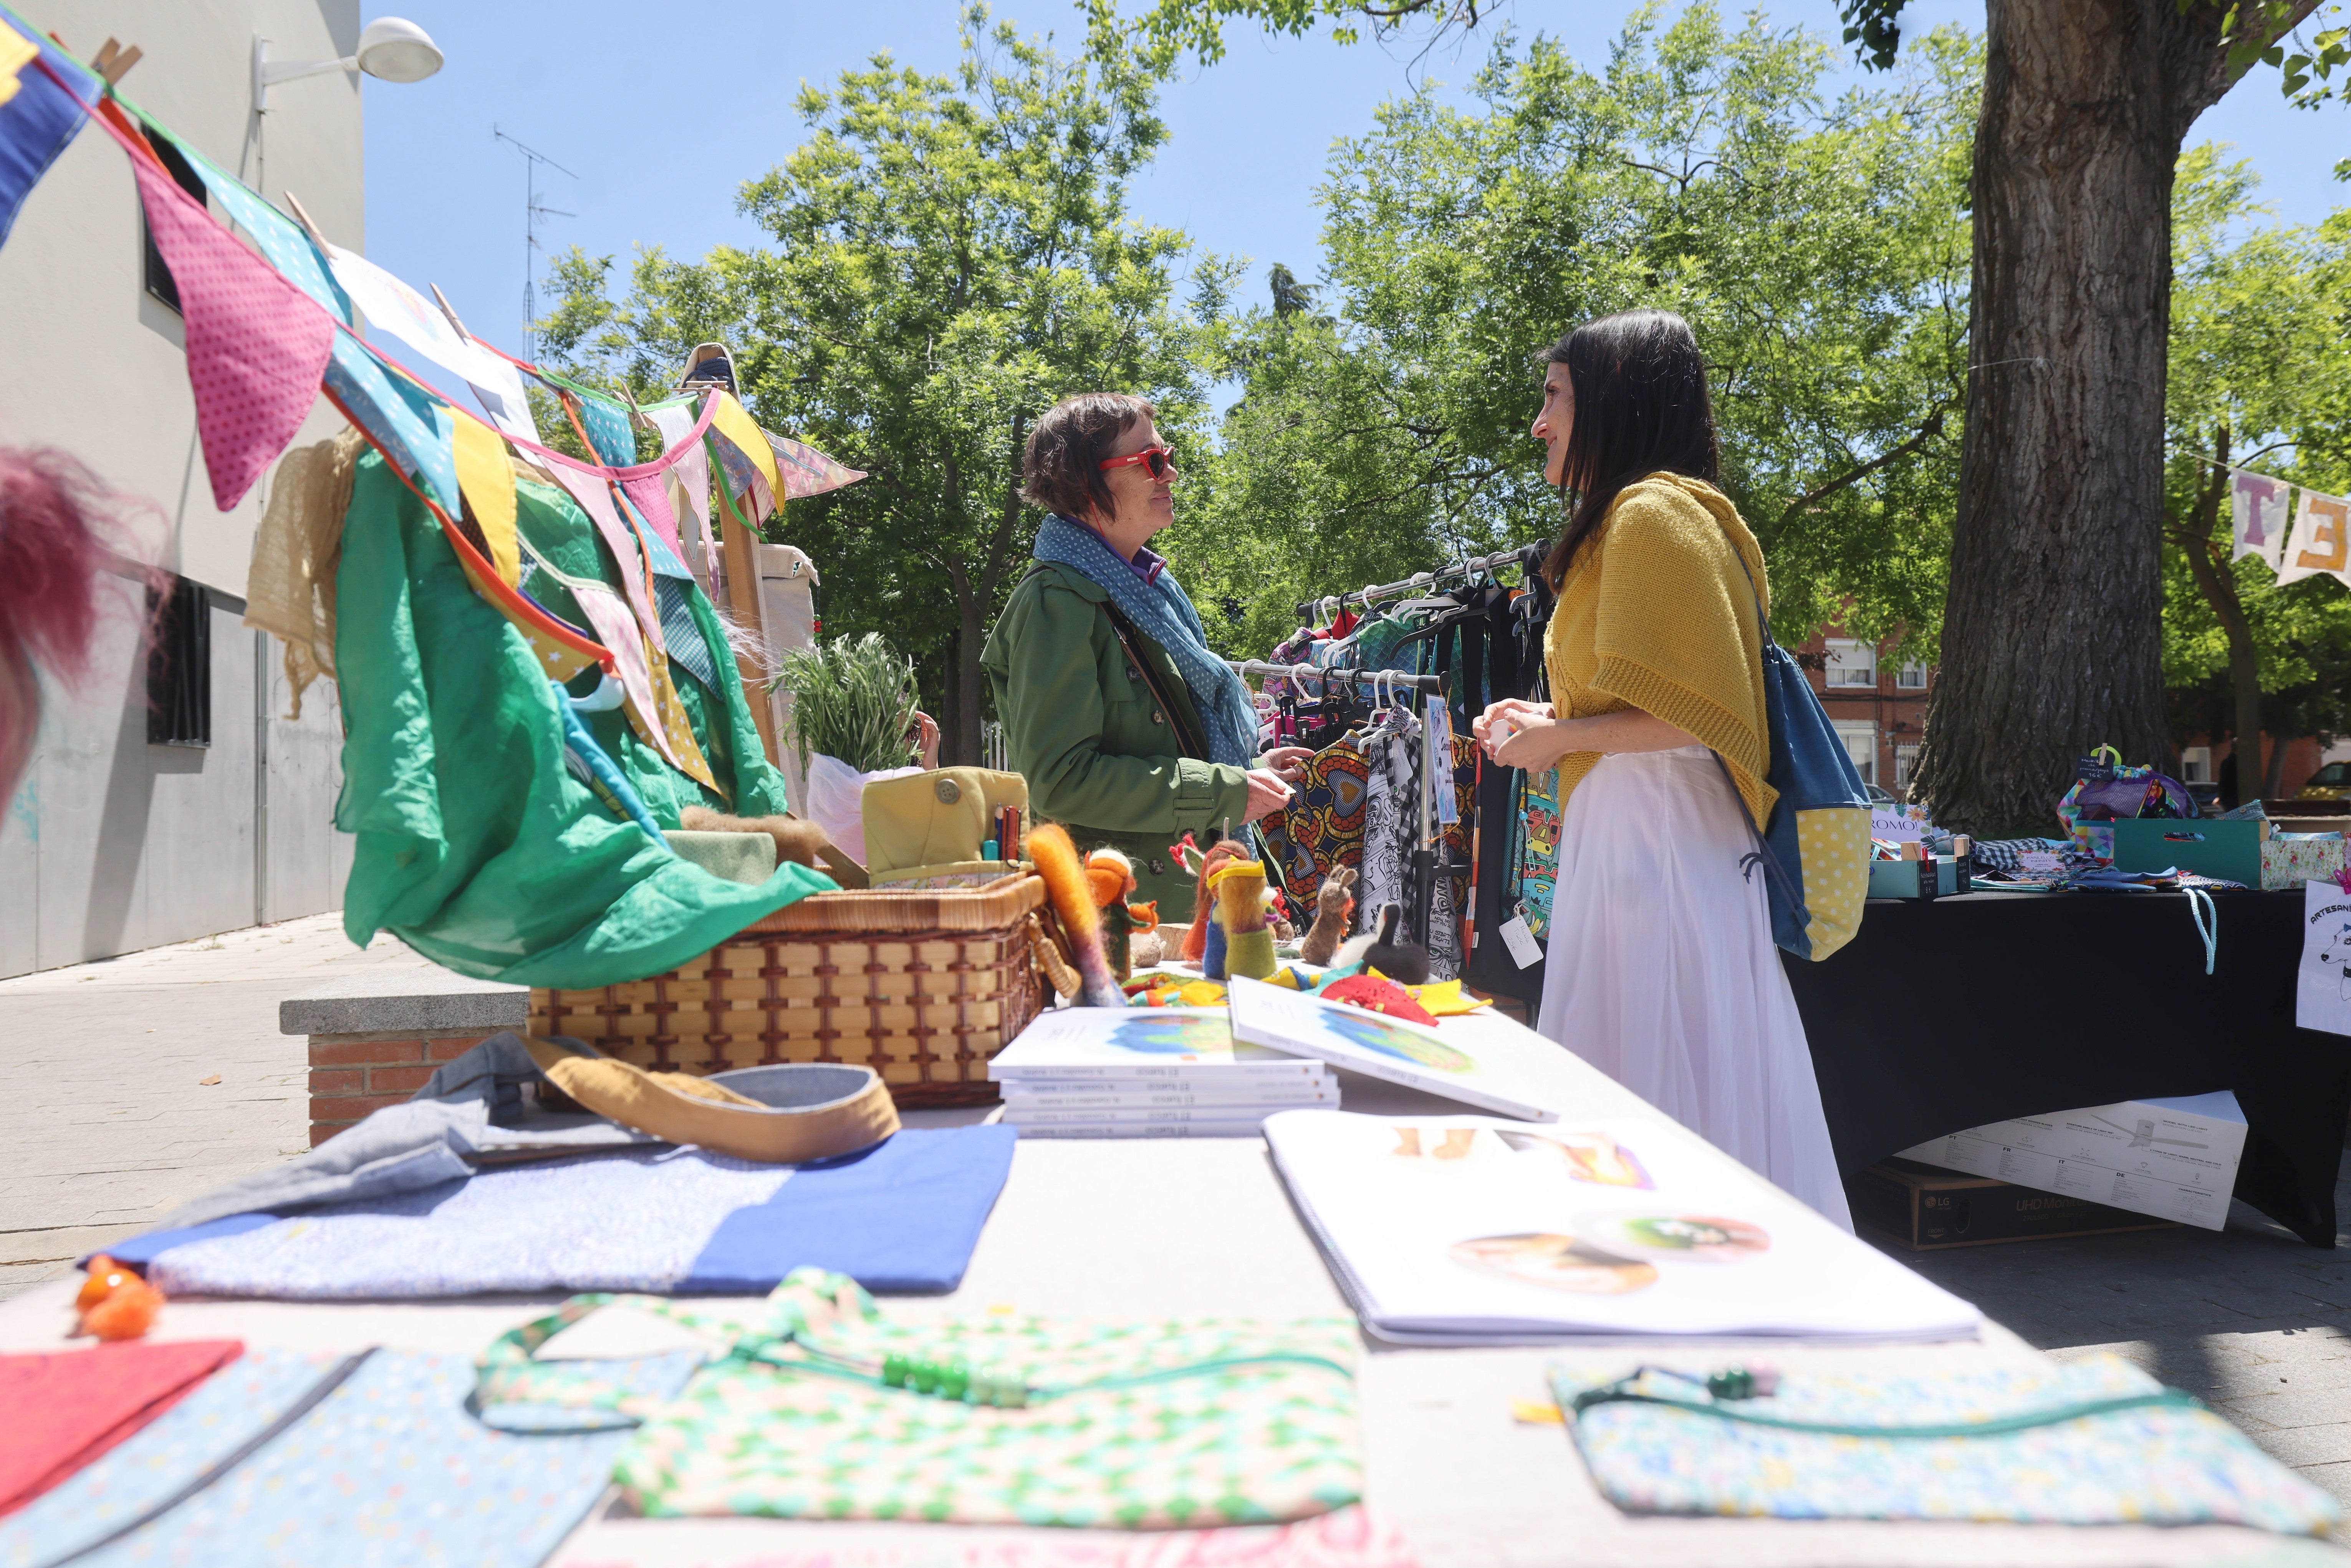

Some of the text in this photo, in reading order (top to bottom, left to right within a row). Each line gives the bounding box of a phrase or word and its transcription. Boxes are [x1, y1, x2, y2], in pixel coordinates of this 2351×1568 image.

[2178, 1188, 2211, 1197] CHARACTERISTICS
[1938, 1197, 1949, 1206] LG
[2016, 1197, 2086, 1211] UHD Monitor
